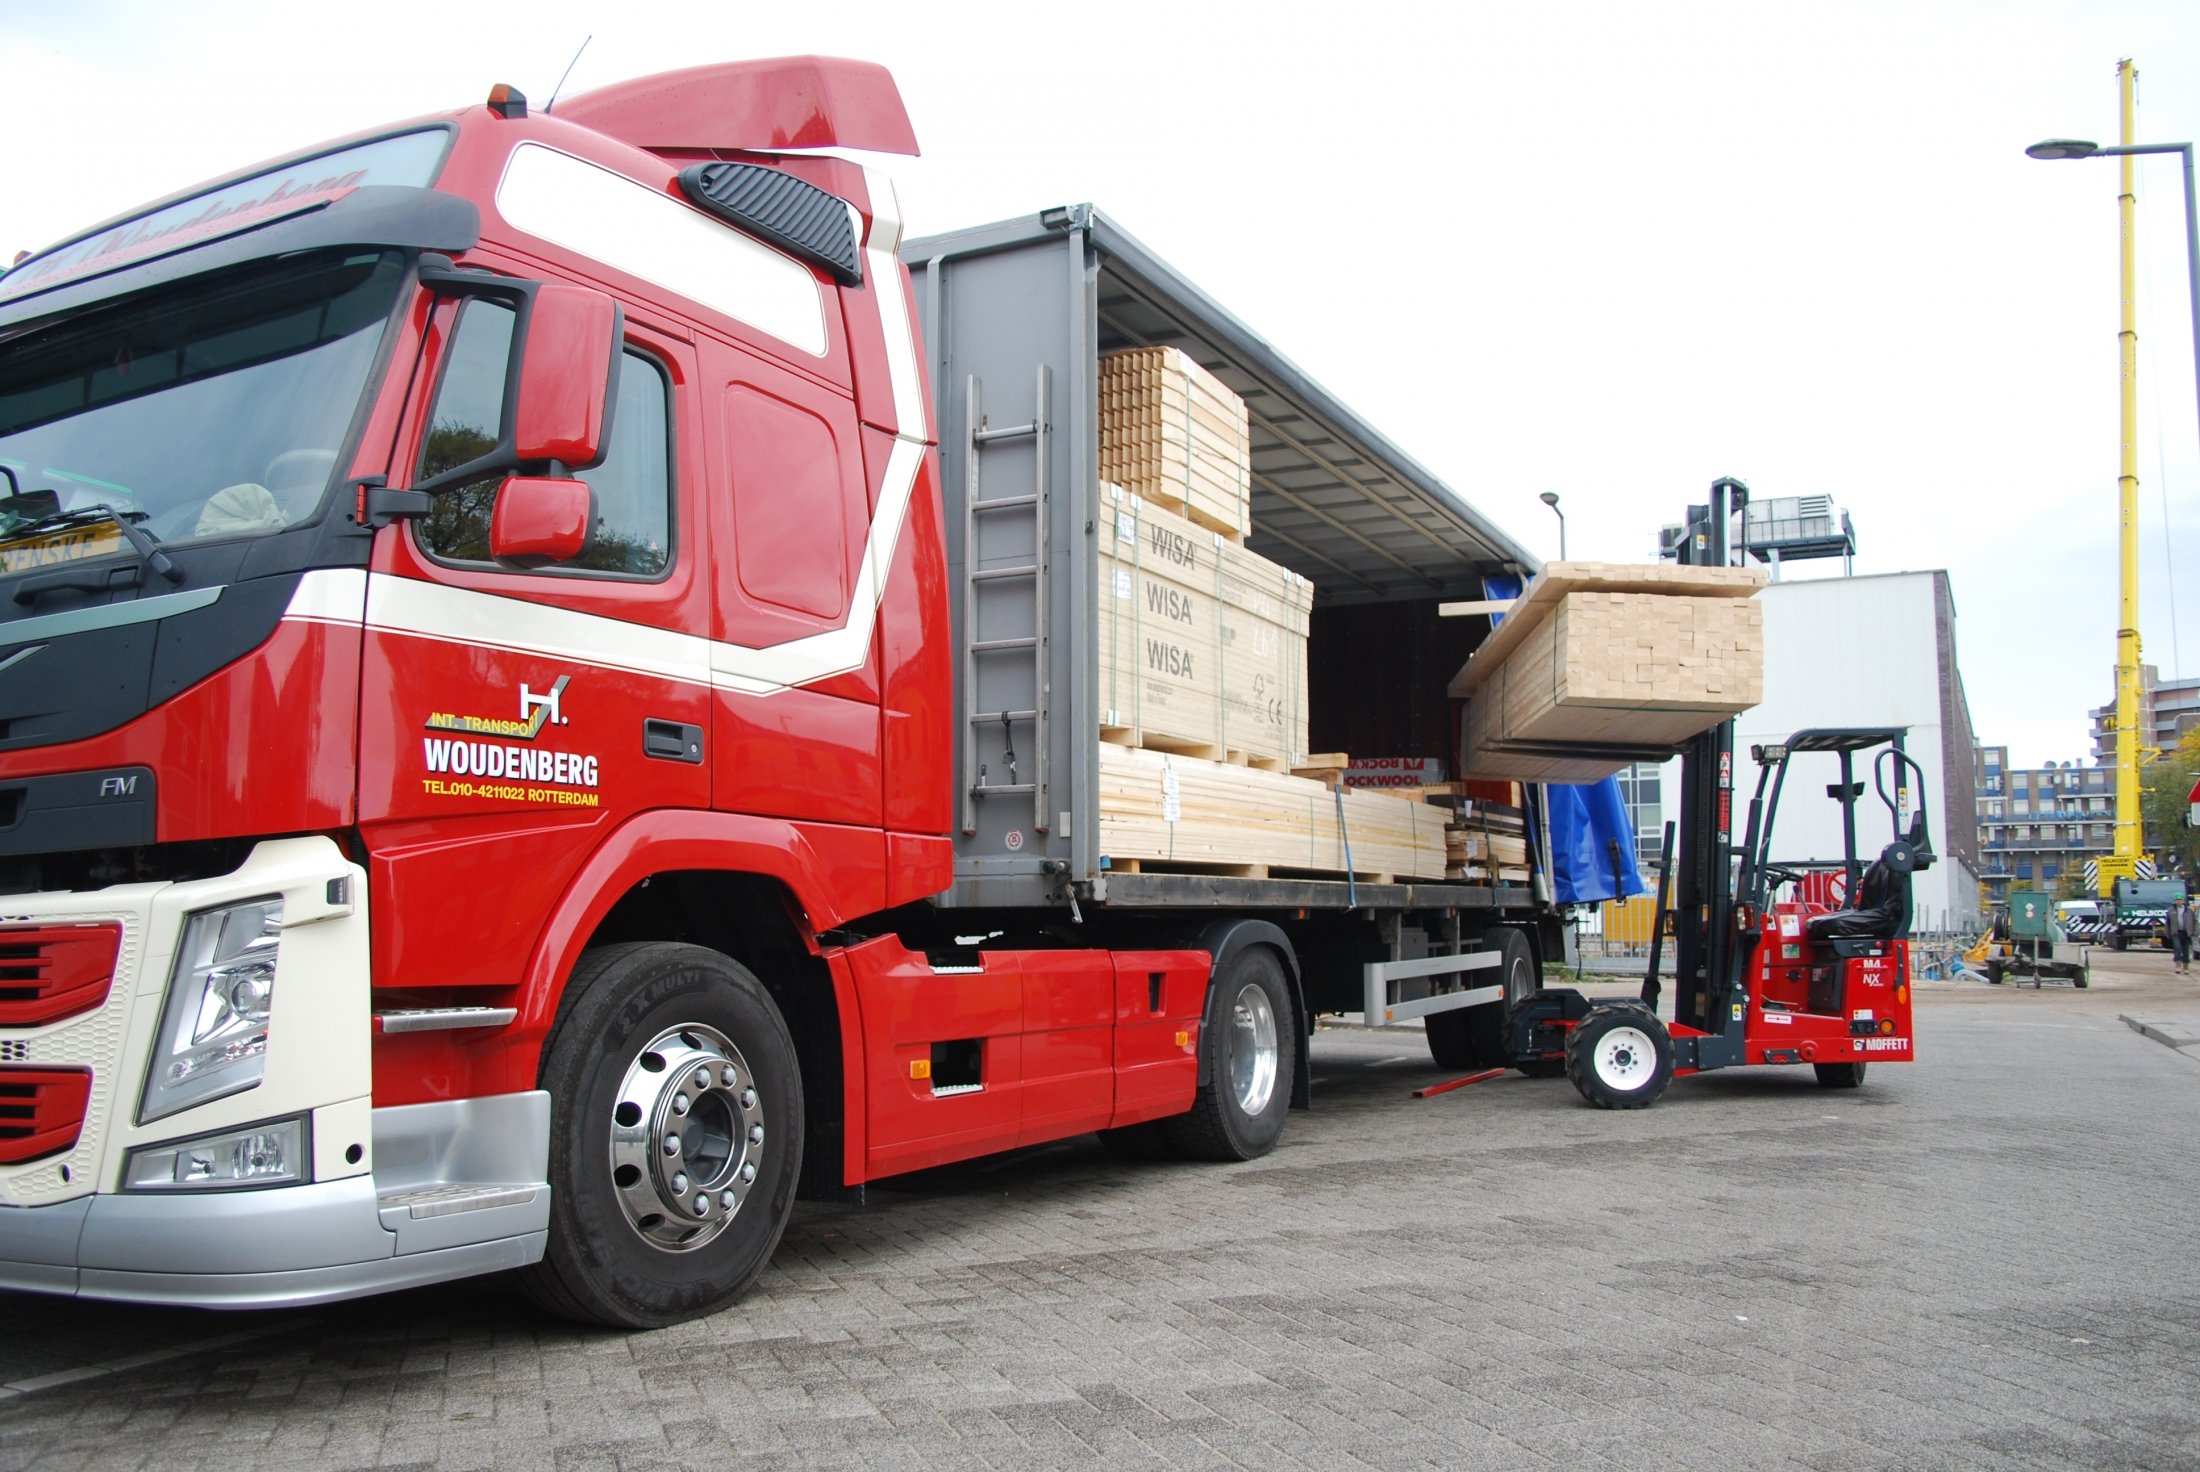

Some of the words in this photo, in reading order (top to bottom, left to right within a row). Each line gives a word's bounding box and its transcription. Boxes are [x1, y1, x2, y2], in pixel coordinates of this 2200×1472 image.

[1150, 523, 1195, 571] WISA
[1146, 580, 1193, 625] WISA
[1146, 637, 1194, 680] WISA
[431, 712, 459, 729] INT.
[463, 706, 540, 737] TRANSPORT
[424, 737, 599, 787] WOUDENBERG
[100, 775, 138, 797] FM
[423, 780, 525, 801] TEL.010-4211022
[528, 788, 599, 807] ROTTERDAM
[1344, 775, 1421, 786] OCKWOOL
[652, 970, 700, 998] MULTI
[1863, 973, 1881, 987] NX
[1866, 1038, 1908, 1051] MOFFETT
